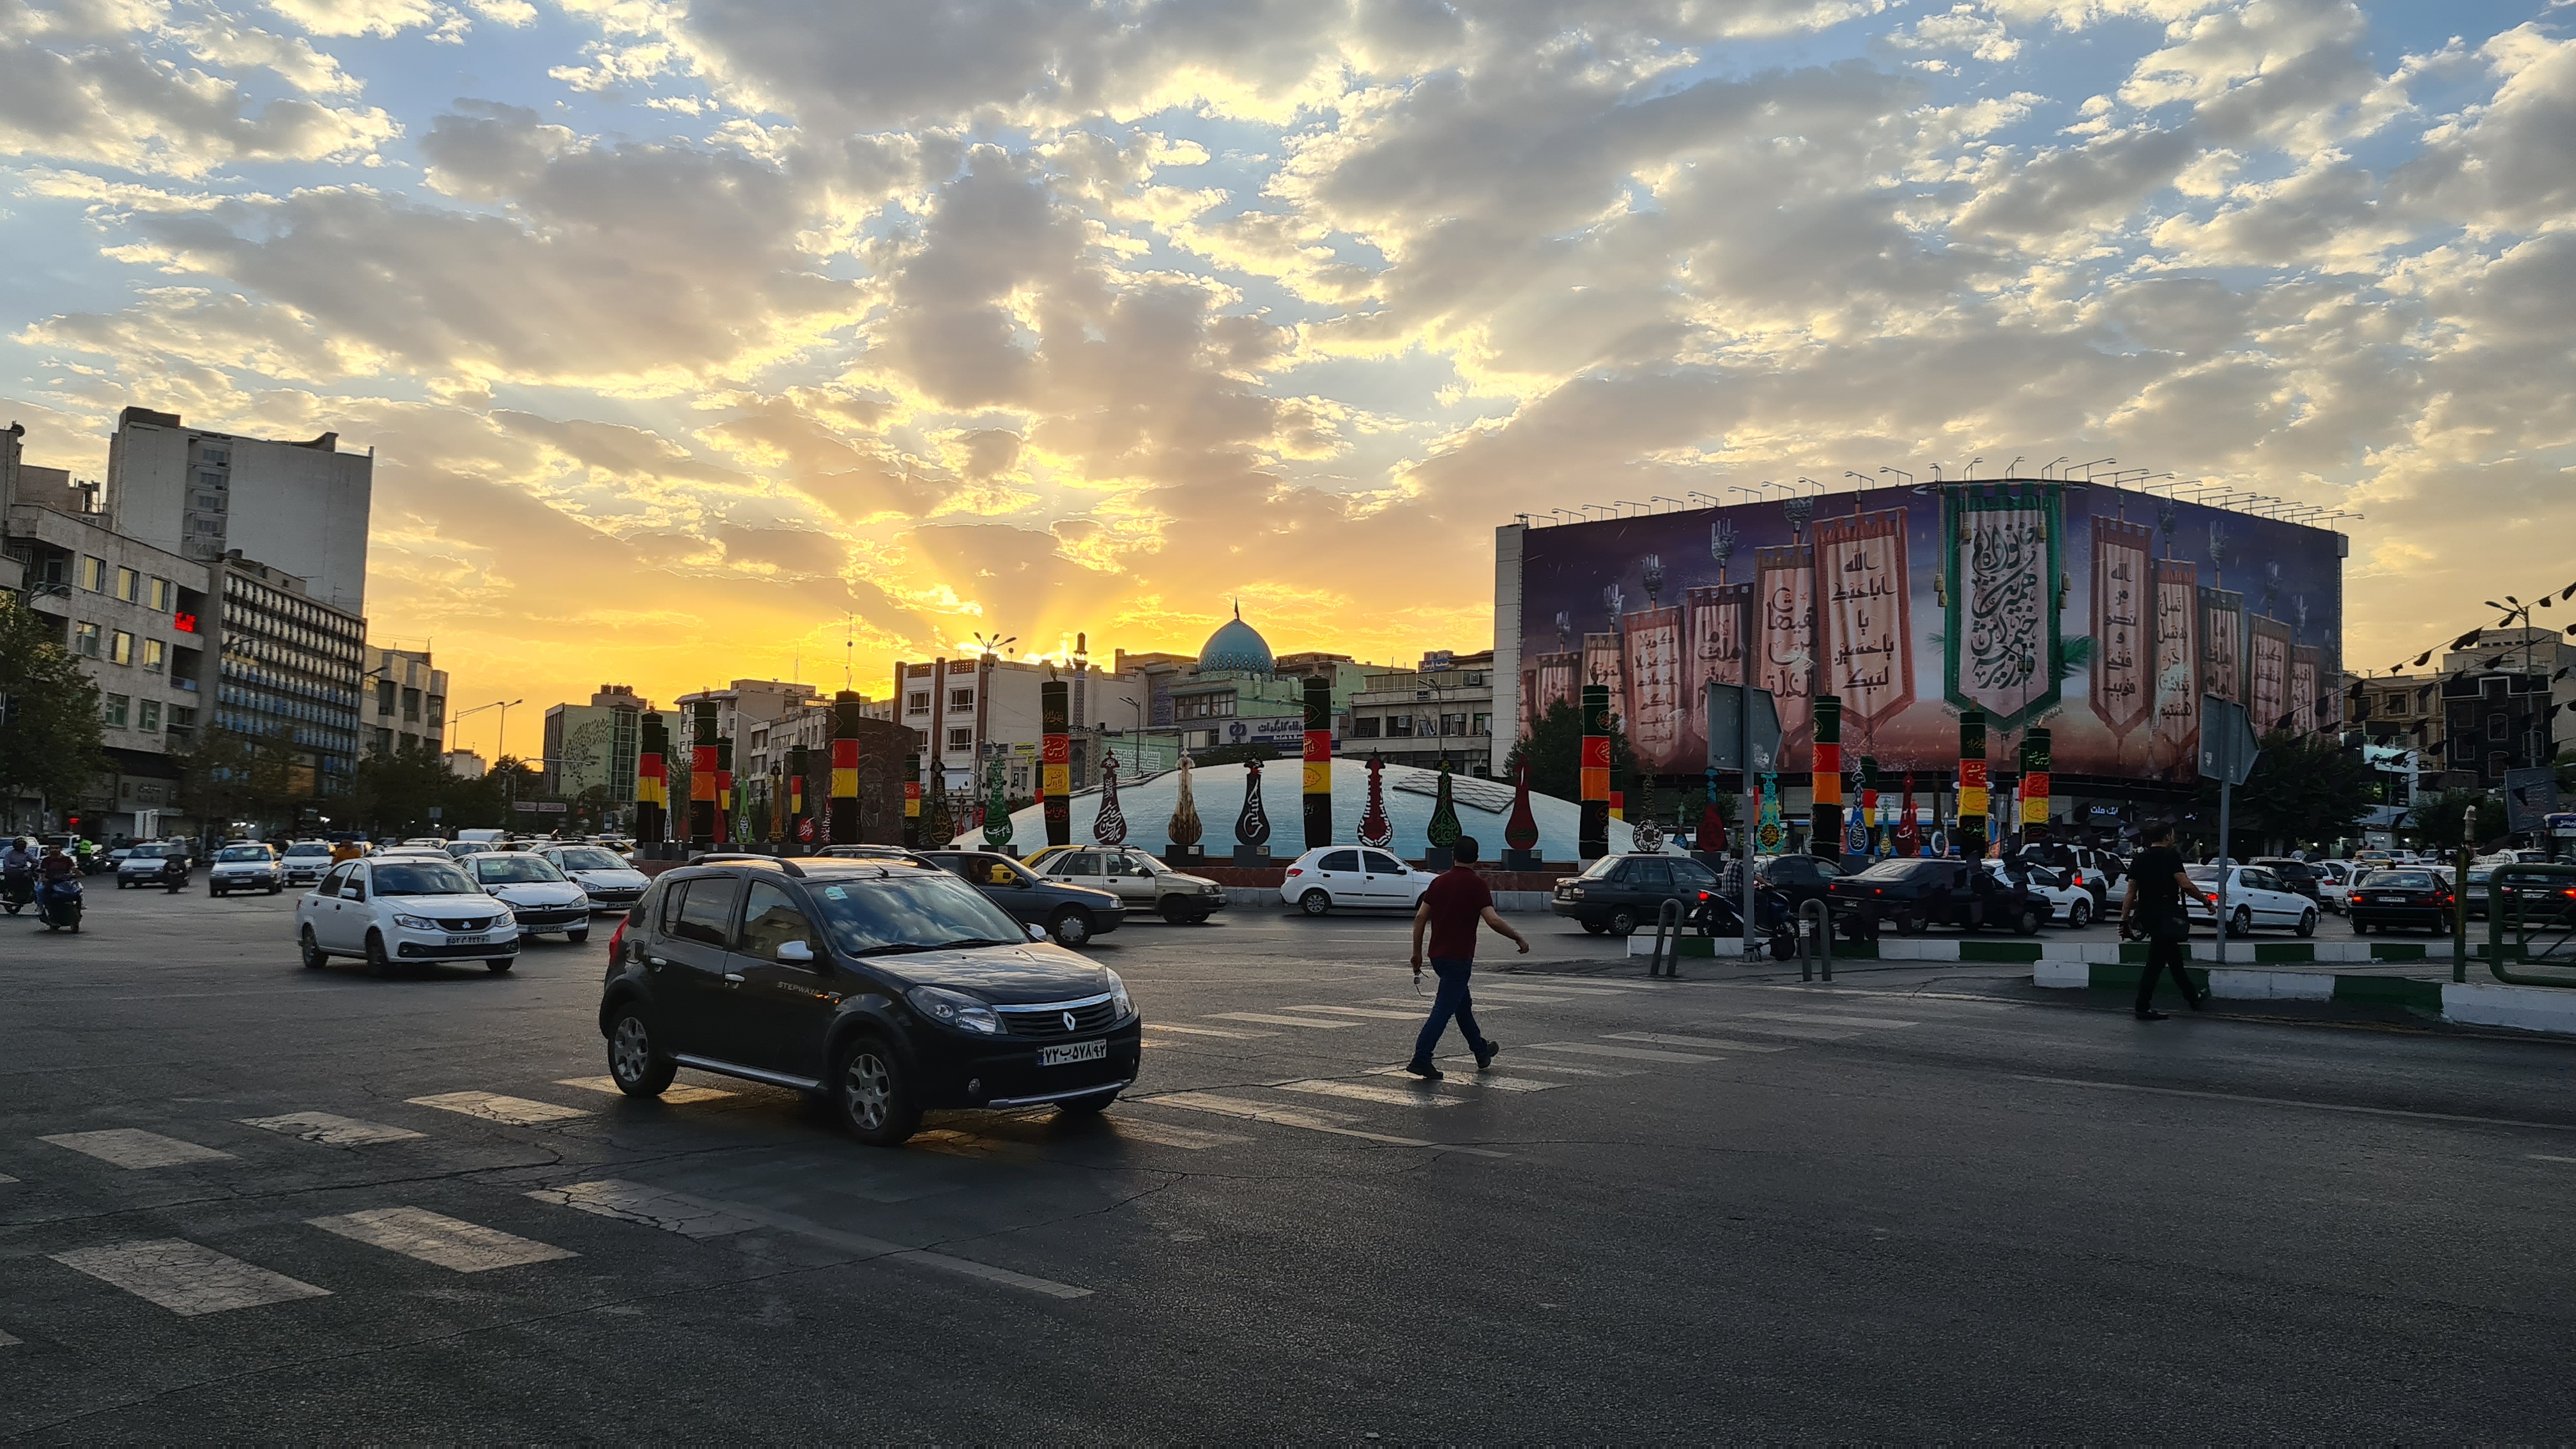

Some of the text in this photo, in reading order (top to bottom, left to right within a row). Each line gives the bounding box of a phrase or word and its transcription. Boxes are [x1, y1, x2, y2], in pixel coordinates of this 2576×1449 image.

[2111, 562, 2133, 582] الله
[2159, 591, 2182, 617] نسل
[1841, 666, 1889, 695] لبیک
[2090, 806, 2105, 815] ملت
[777, 981, 816, 996] STEPWAY
